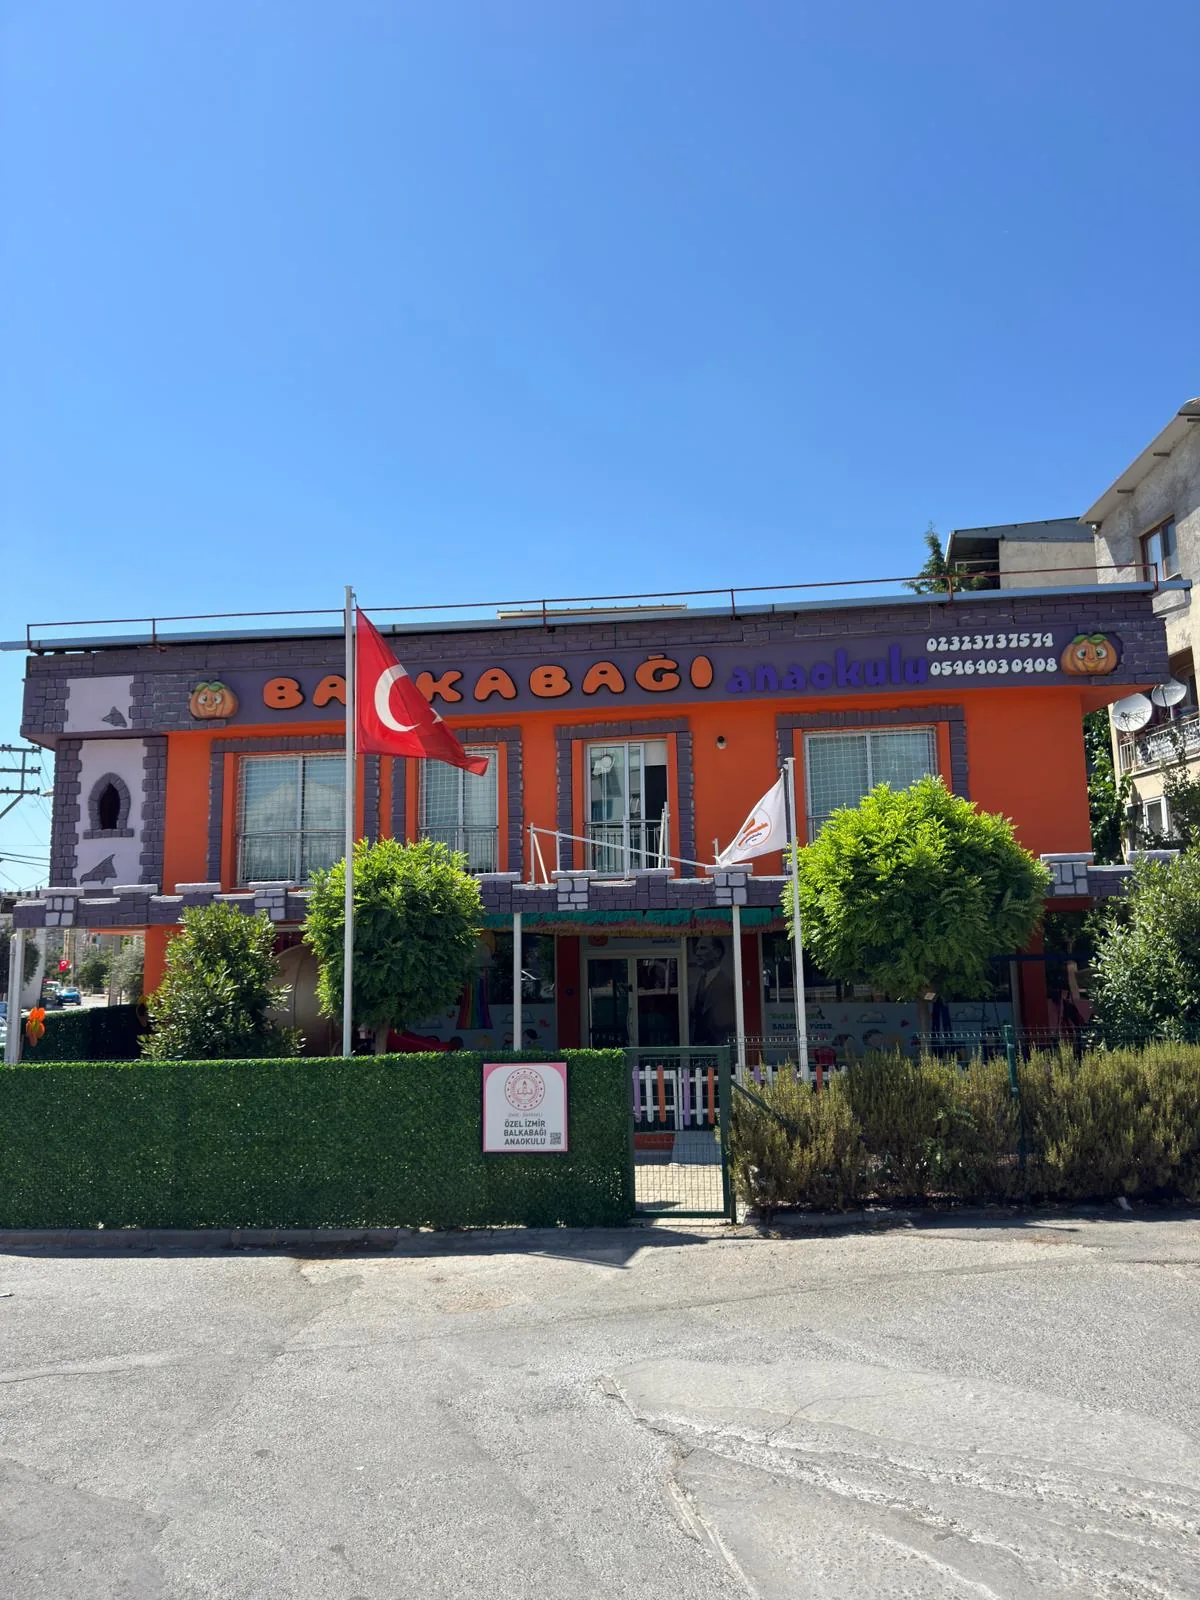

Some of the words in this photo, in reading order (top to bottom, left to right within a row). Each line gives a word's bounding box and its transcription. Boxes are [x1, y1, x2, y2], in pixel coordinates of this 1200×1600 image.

[927, 633, 1054, 652] 02323737574
[262, 653, 713, 709] BAKABAĞI
[726, 643, 929, 694] anaokulu
[504, 1118, 523, 1128] ÖZEL
[524, 1118, 546, 1128] İZMİR
[503, 1128, 547, 1137] BALKABAĞI
